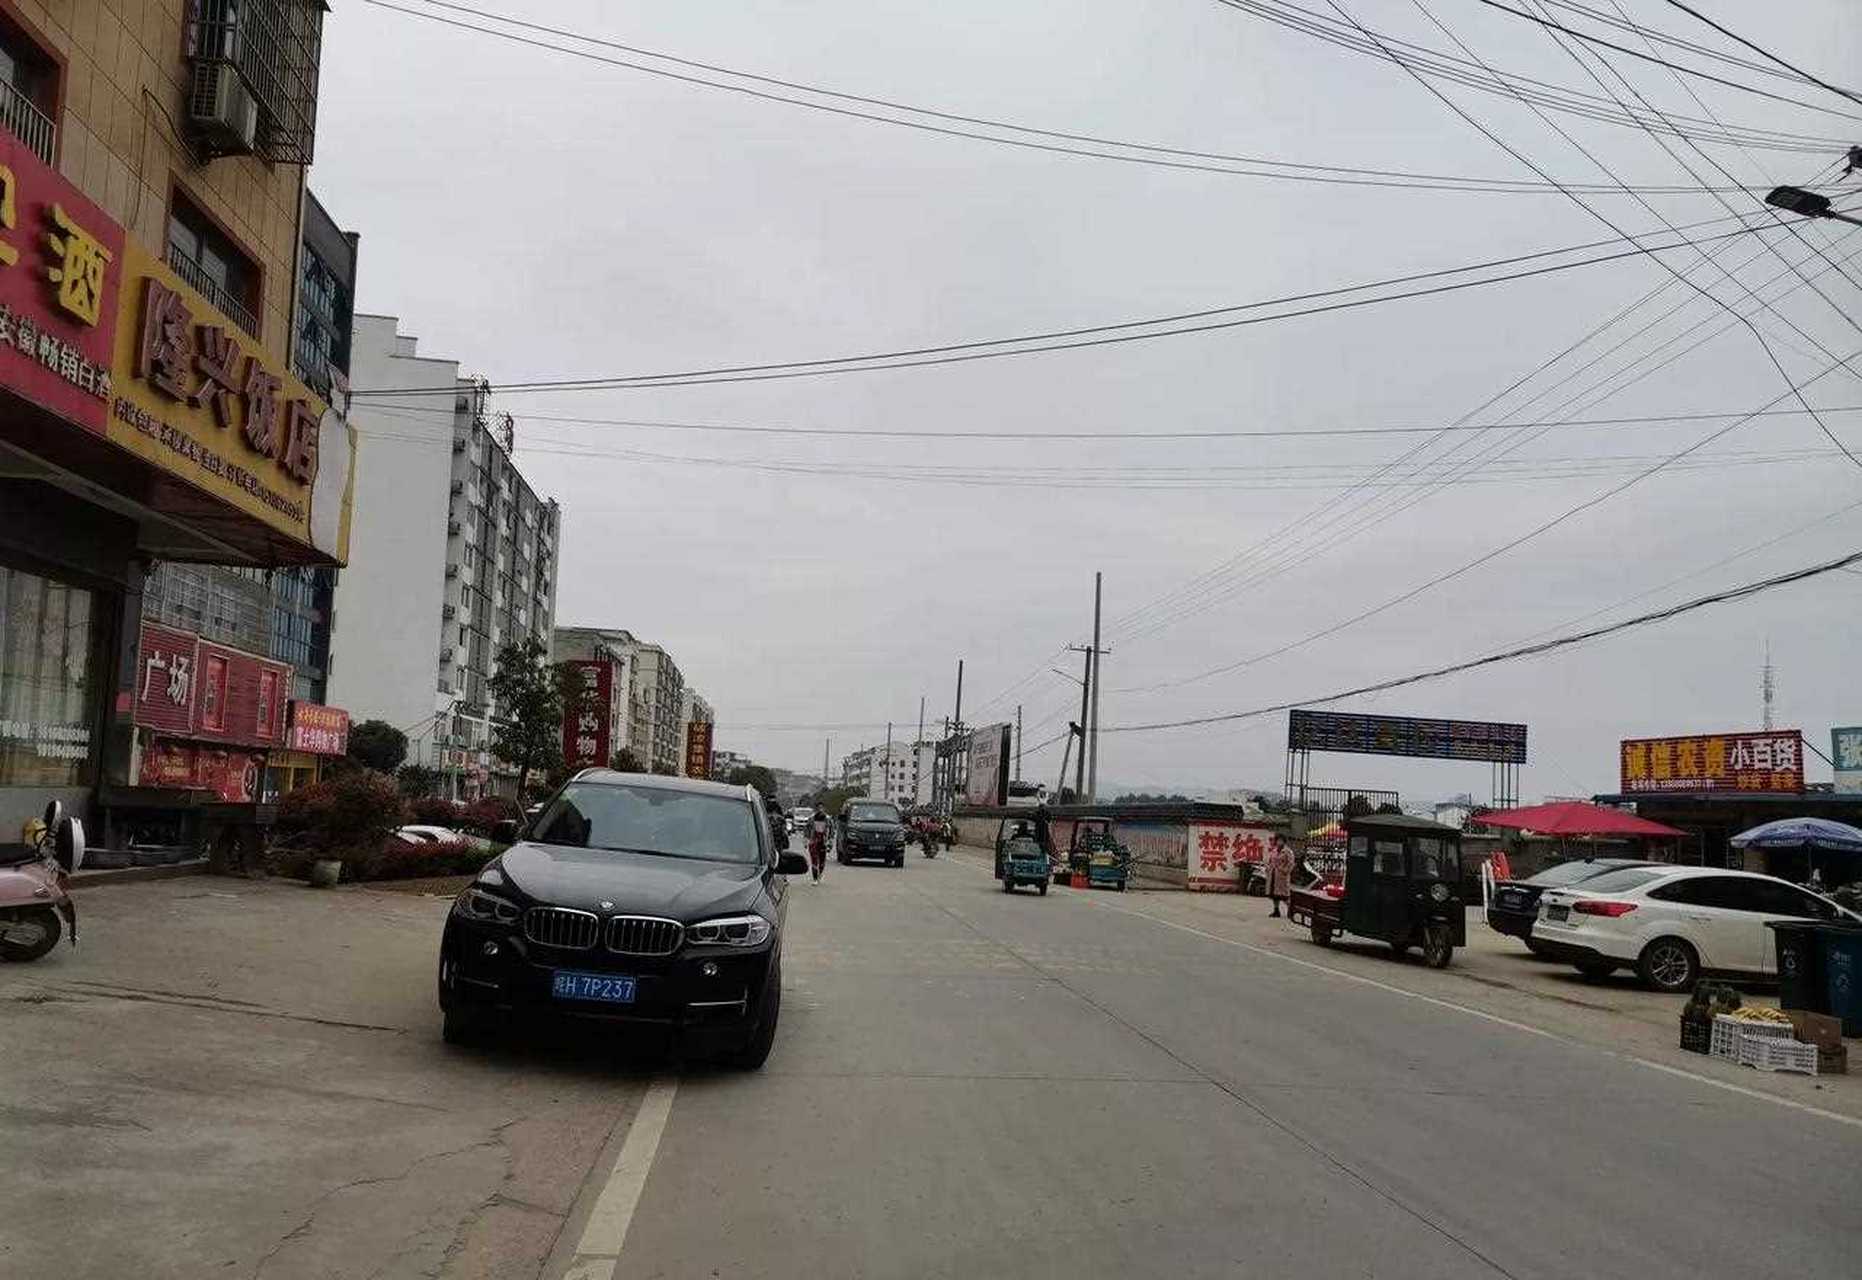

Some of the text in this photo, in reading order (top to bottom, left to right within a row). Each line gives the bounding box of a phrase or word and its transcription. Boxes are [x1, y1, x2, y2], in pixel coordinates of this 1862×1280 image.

[142, 650, 190, 706] 广场
[1730, 738, 1796, 773] 小百货
